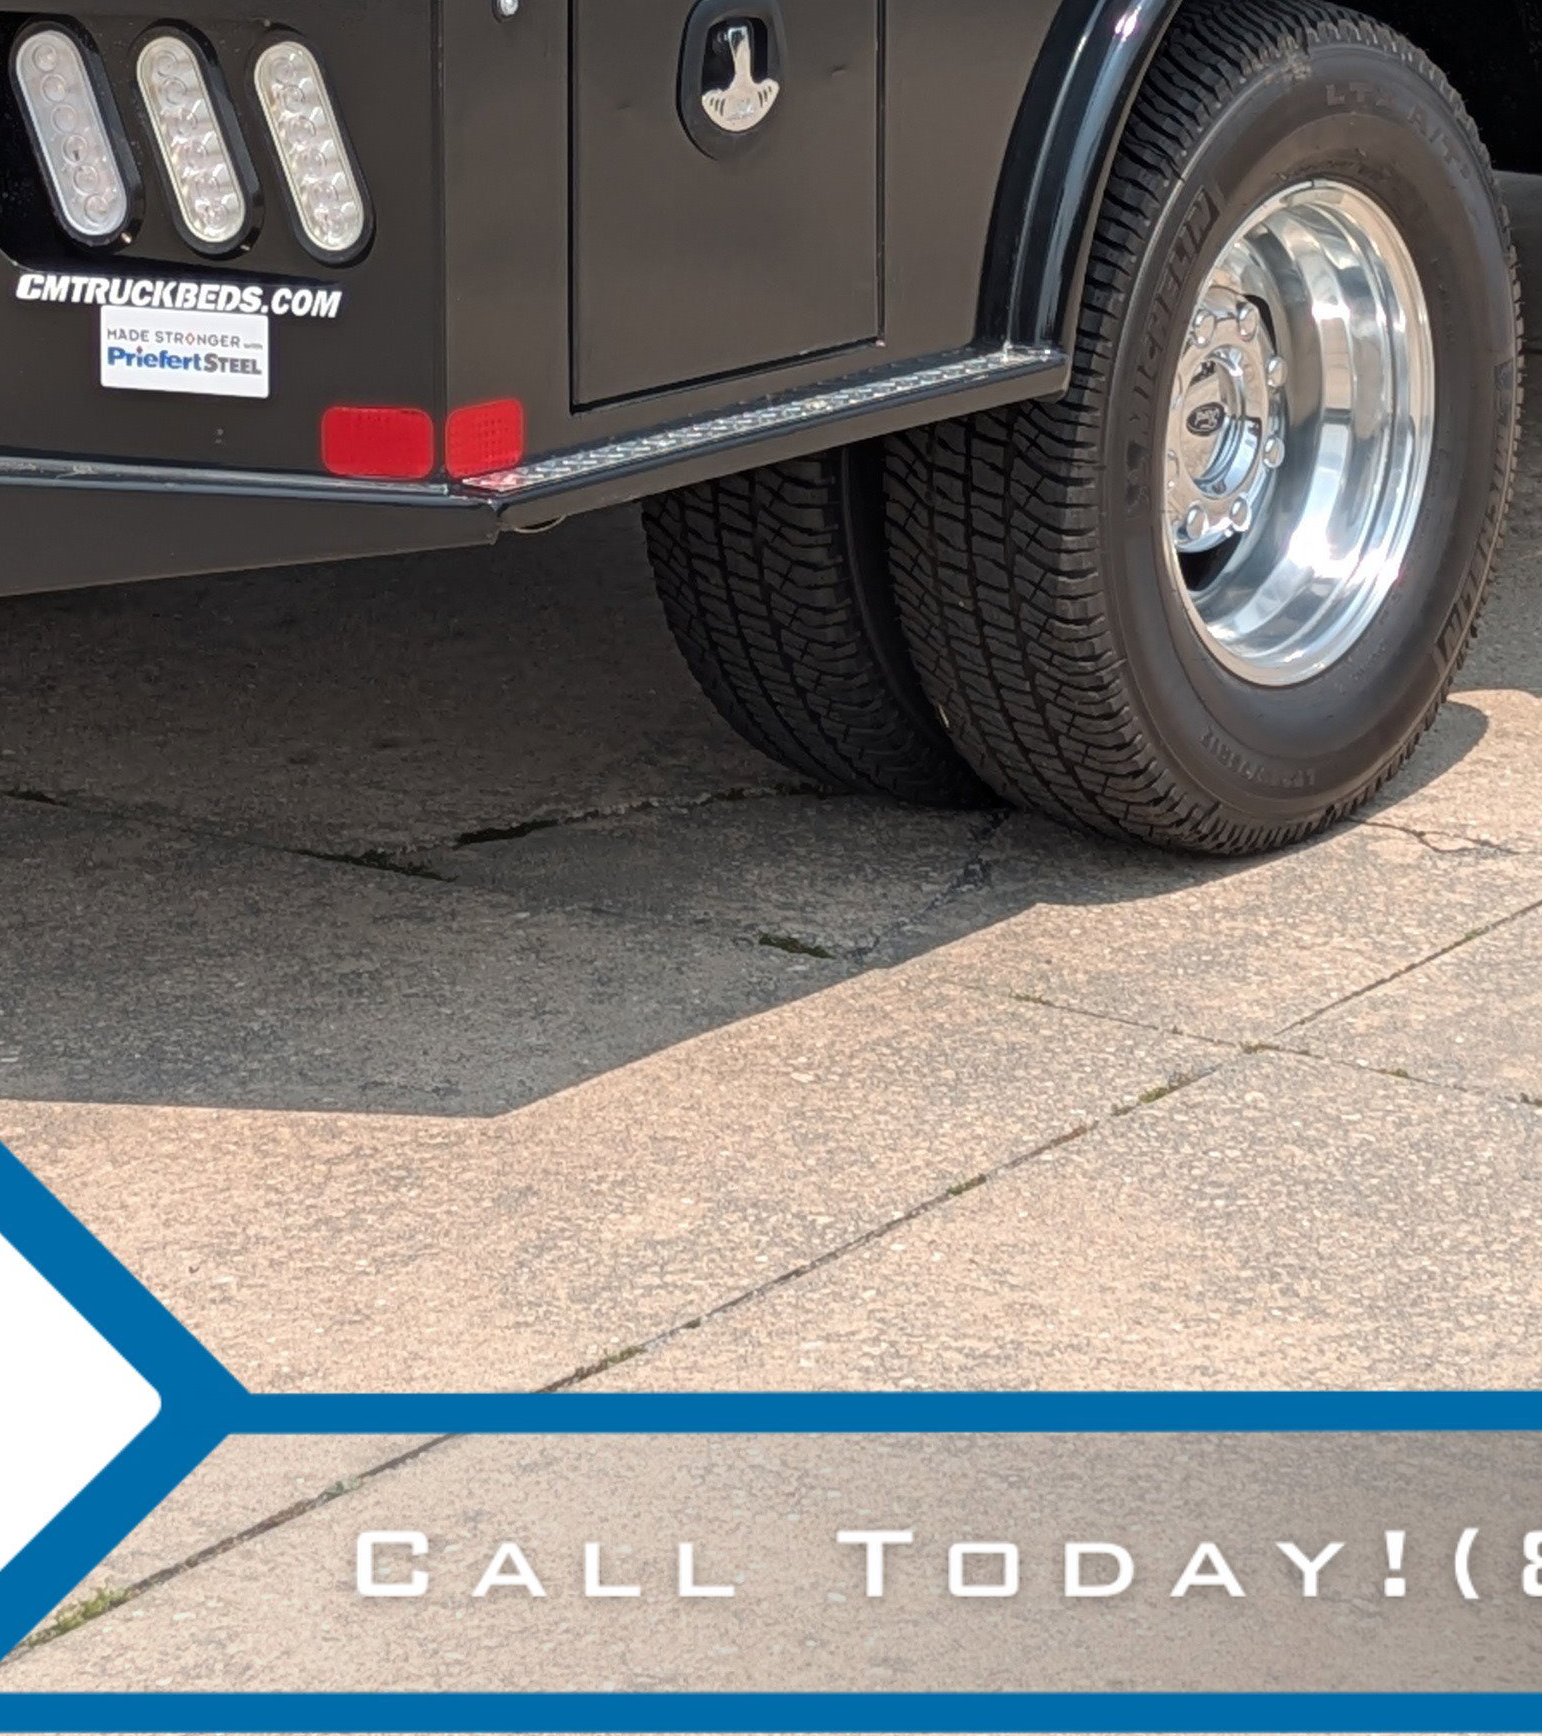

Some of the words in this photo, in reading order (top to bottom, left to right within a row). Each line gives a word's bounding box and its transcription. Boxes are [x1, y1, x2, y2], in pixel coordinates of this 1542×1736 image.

[15, 272, 343, 319] CMTRUCKBEDS.COM
[106, 327, 151, 343] MADE
[154, 330, 241, 348] STRONGER
